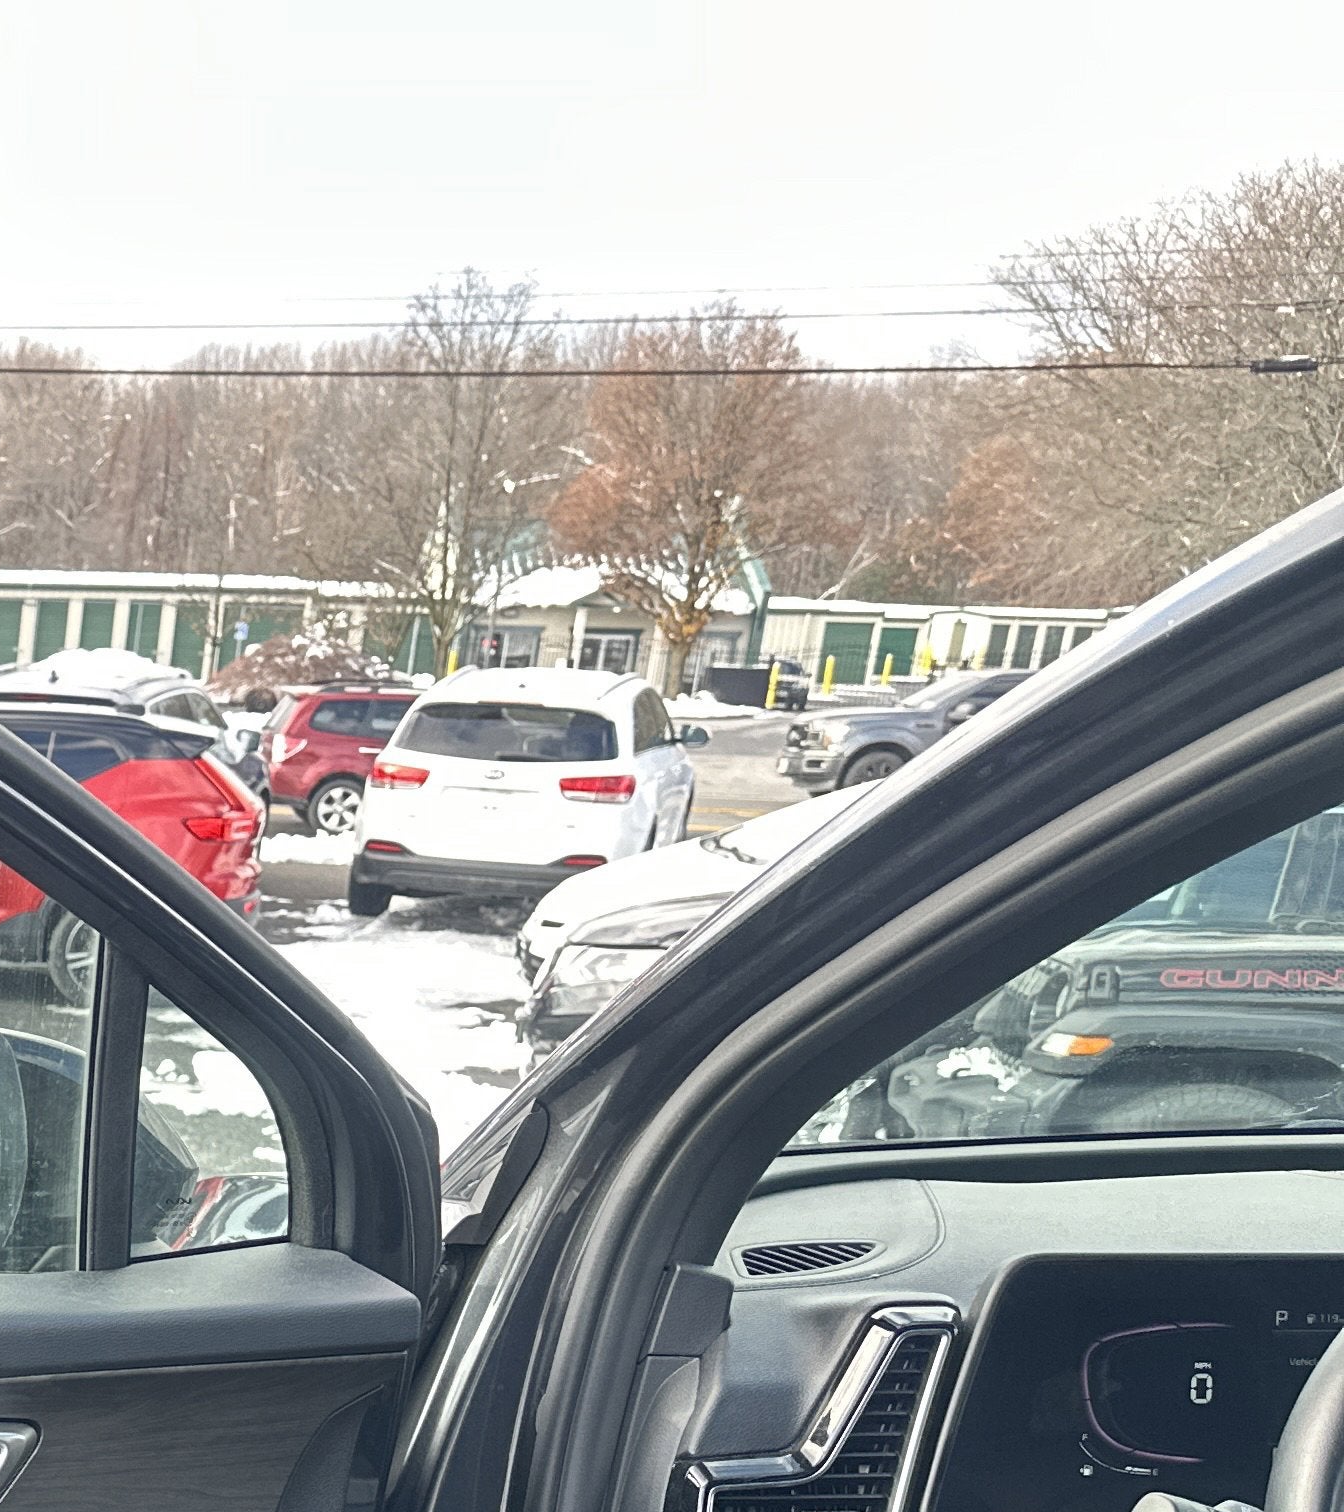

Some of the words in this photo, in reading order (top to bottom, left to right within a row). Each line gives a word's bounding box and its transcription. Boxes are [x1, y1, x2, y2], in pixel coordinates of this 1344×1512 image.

[1275, 1309, 1289, 1327] P
[1193, 1361, 1212, 1370] MPH
[1289, 1357, 1318, 1367] Vehicl
[1190, 1372, 1213, 1405] 0
